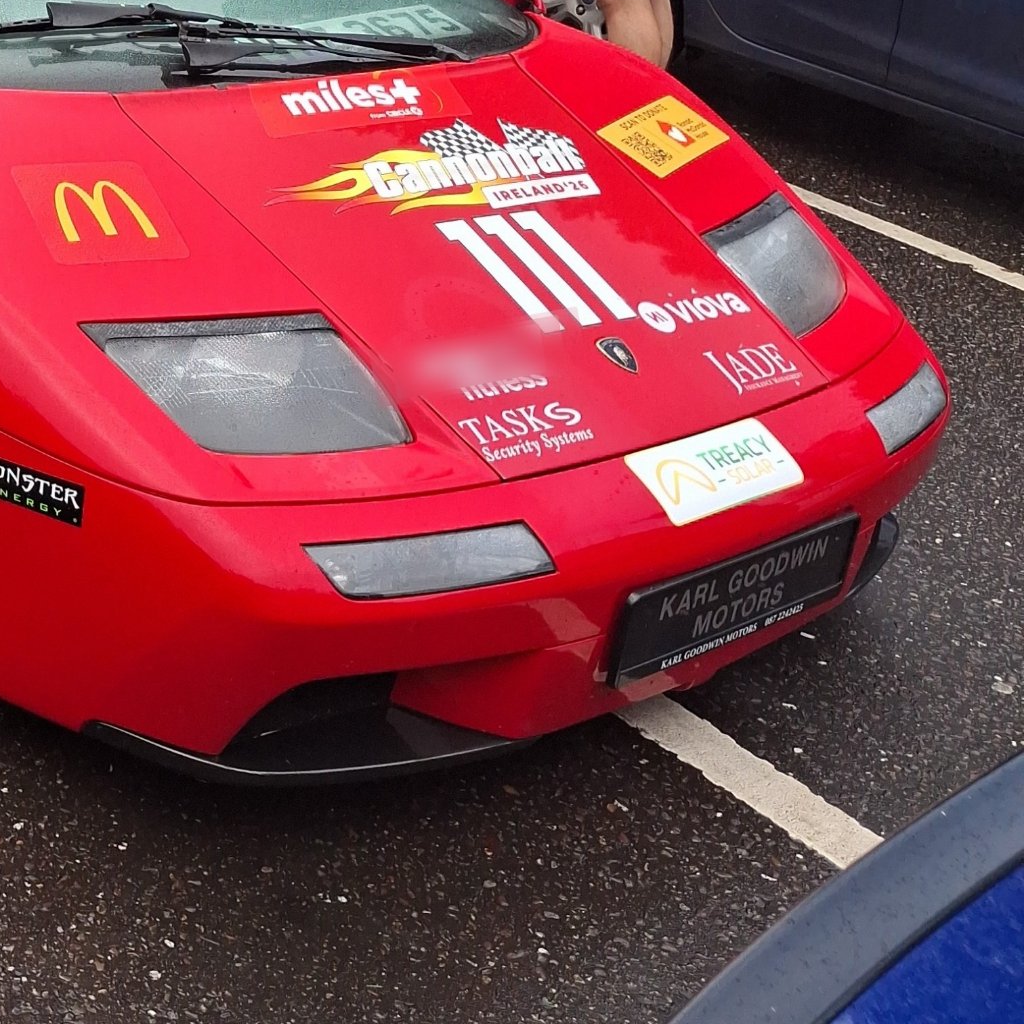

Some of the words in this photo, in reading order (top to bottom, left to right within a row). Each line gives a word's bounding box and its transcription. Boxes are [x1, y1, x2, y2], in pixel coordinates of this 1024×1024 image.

[363, 137, 585, 199] Cannonball
[434, 210, 638, 334] 111
[703, 343, 797, 396] JADE
[482, 439, 542, 463] Security
[540, 428, 594, 453] Systems
[695, 434, 772, 471] TREACY
[727, 458, 776, 485] SOLAR
[659, 579, 720, 621] KARL
[728, 536, 829, 594] GOODWIN
[691, 582, 785, 638] MOTORS
[660, 653, 682, 669] KARL
[683, 636, 725, 661] GOODWIN
[724, 622, 758, 644] MOTORS
